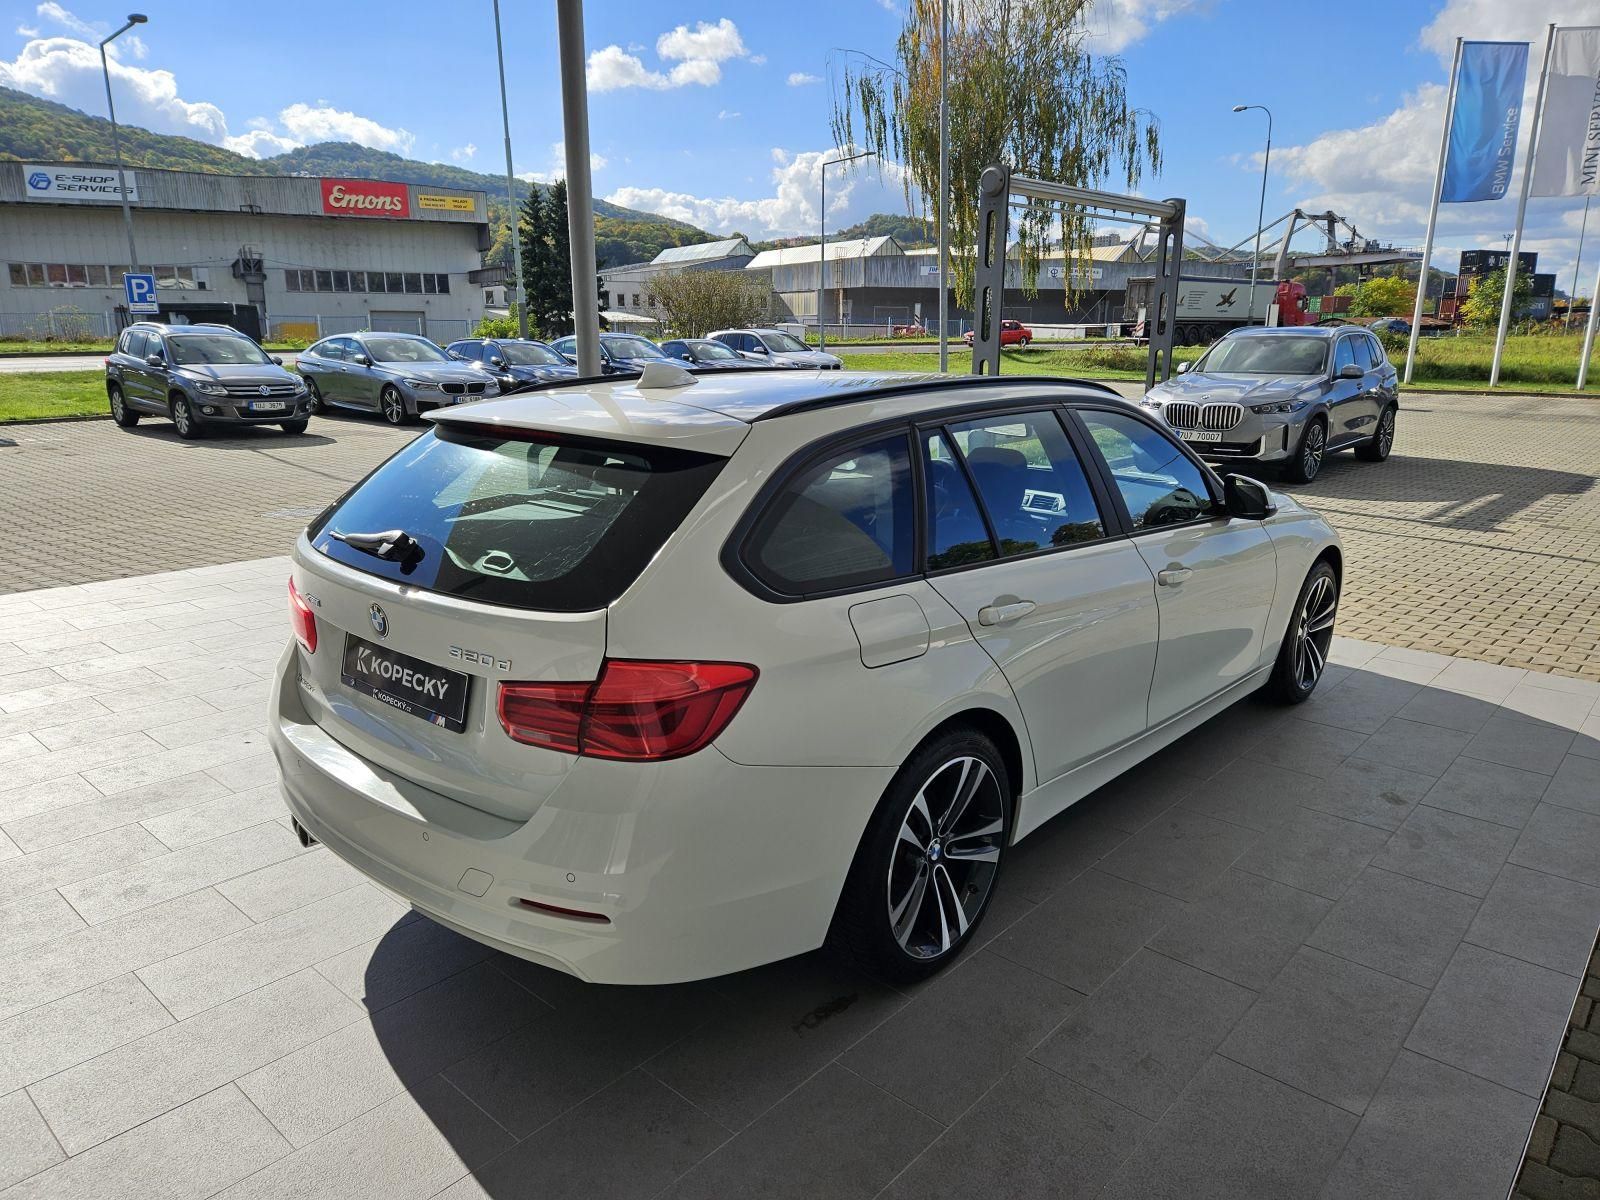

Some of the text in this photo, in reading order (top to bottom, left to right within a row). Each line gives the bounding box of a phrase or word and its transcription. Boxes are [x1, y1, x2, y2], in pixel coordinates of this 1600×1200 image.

[1492, 107, 1518, 194] BMW Service
[1581, 146, 1600, 185] MINI
[55, 174, 115, 184] E-SHOP
[56, 183, 134, 194] SERVICES
[328, 185, 402, 211] Emons
[131, 279, 149, 302] P
[1180, 431, 1220, 441] 7U7 70007
[448, 645, 512, 672] 320d
[371, 656, 449, 700] KOPECKÝ
